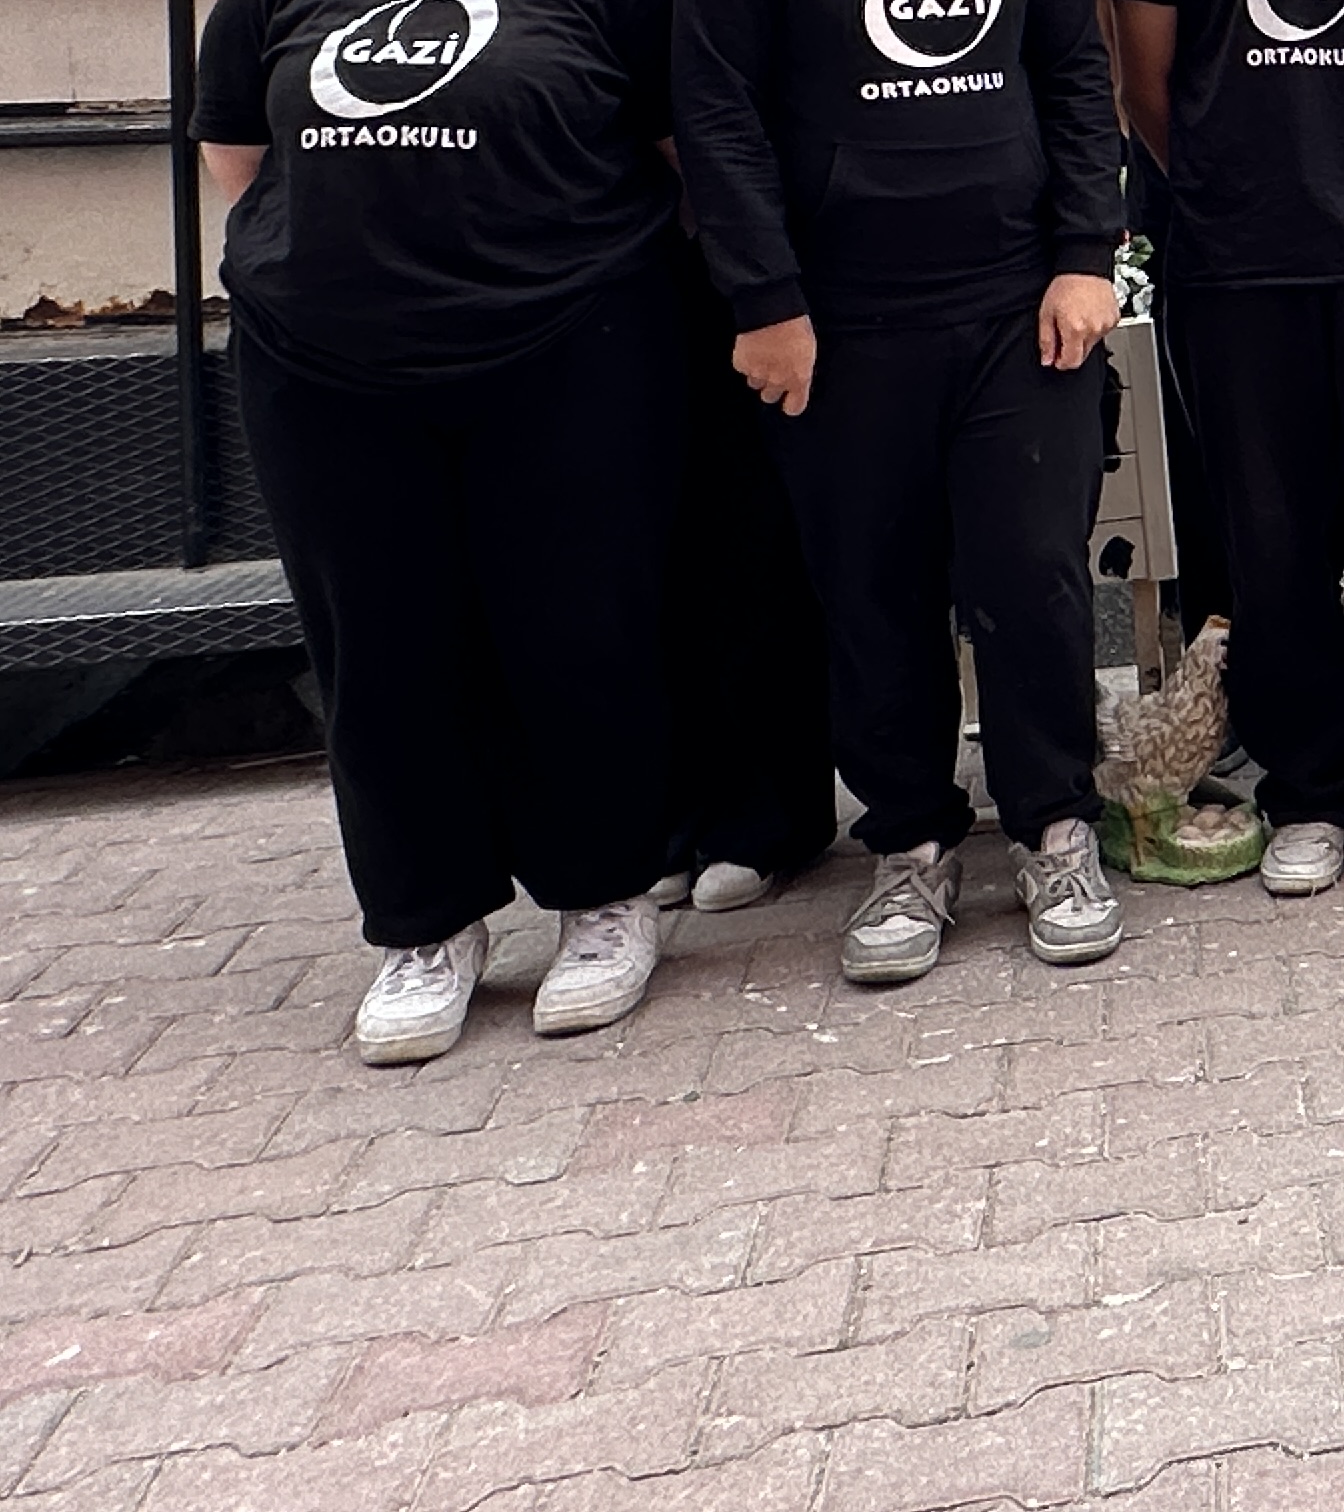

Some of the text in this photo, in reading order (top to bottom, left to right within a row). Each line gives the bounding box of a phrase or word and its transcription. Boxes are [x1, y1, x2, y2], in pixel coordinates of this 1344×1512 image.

[342, 33, 461, 65] GAZİ
[860, 71, 1004, 100] ORTAOKULU
[300, 124, 478, 150] ORTAOKULU
